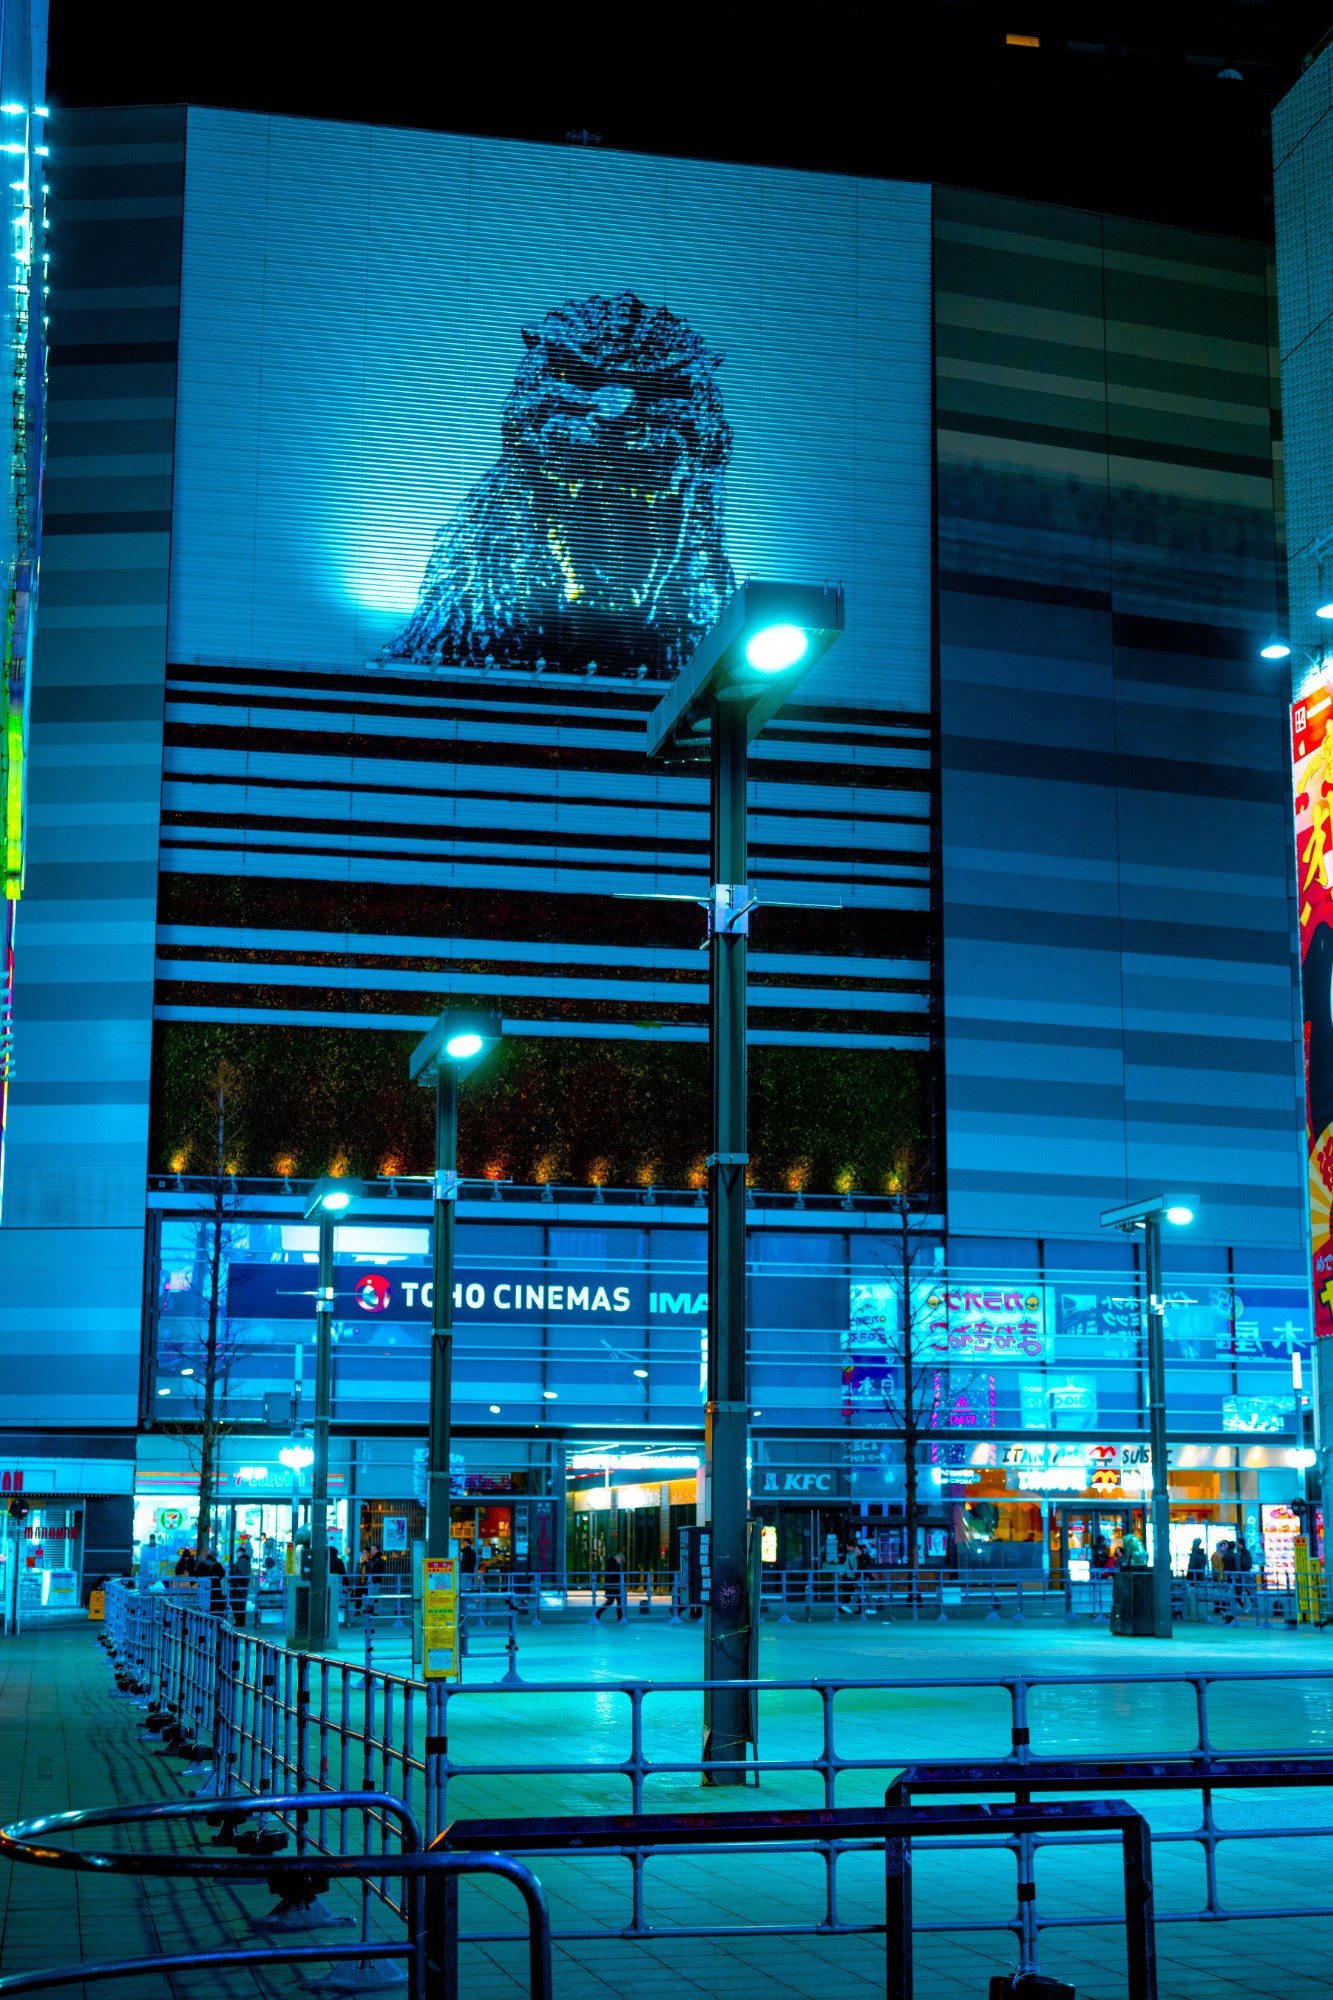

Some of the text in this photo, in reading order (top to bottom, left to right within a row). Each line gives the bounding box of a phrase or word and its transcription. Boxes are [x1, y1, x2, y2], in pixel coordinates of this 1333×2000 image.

[401, 1282, 631, 1312] TOHO CINEMAS
[649, 1292, 708, 1314] IMA
[1122, 1449, 1172, 1465] SUSI
[784, 1474, 831, 1491] KFC
